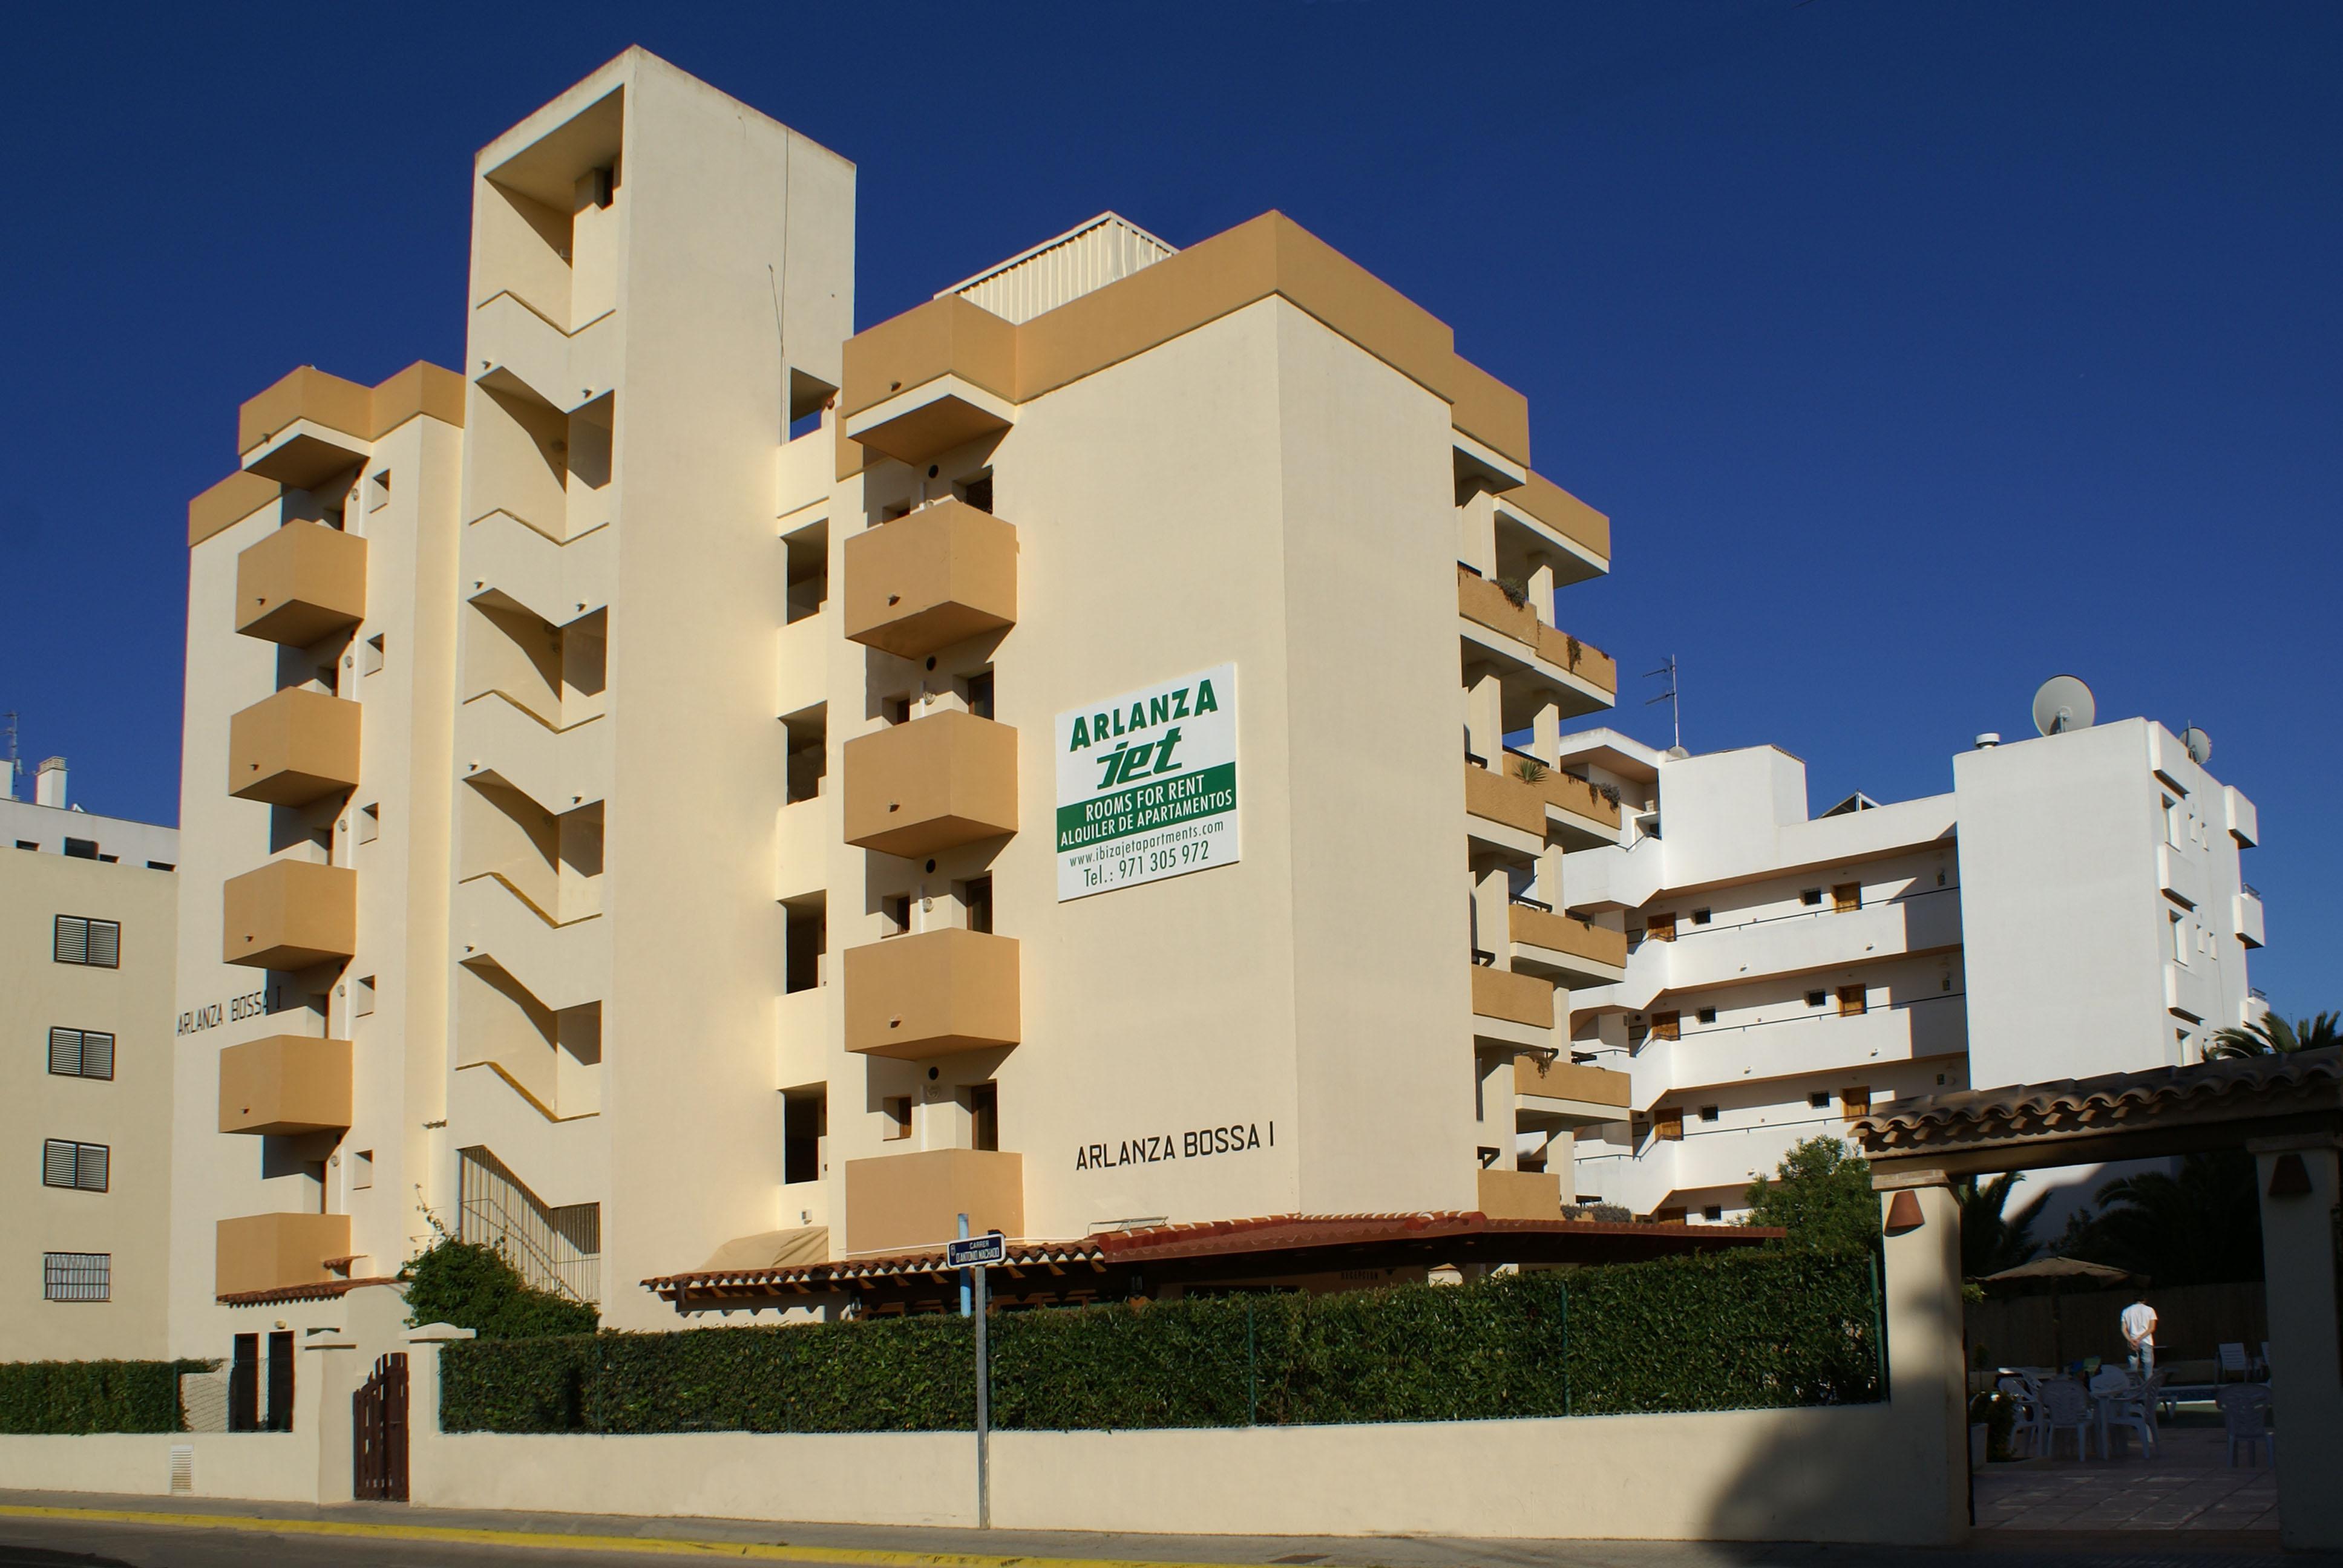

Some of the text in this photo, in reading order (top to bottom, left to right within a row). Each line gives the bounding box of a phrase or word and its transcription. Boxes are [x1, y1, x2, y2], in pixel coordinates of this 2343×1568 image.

[1070, 679, 1217, 752] ARLANZA
[1096, 727, 1182, 790] jet
[1061, 789, 1232, 847] ALQUILER DE APARTAMENTOS
[1086, 774, 1204, 822] ROOMS FOR RENT
[1070, 820, 1224, 867] www.ibizajetapartments.com
[1084, 840, 1209, 887] Tel.: 971 305 972
[177, 1003, 223, 1037] ARLANZA
[231, 991, 268, 1022] BOSSA
[1076, 1120, 1274, 1171] ARLANZA BOSSA I
[969, 1240, 989, 1249] CARRER
[978, 1247, 1000, 1259] MACHADO
